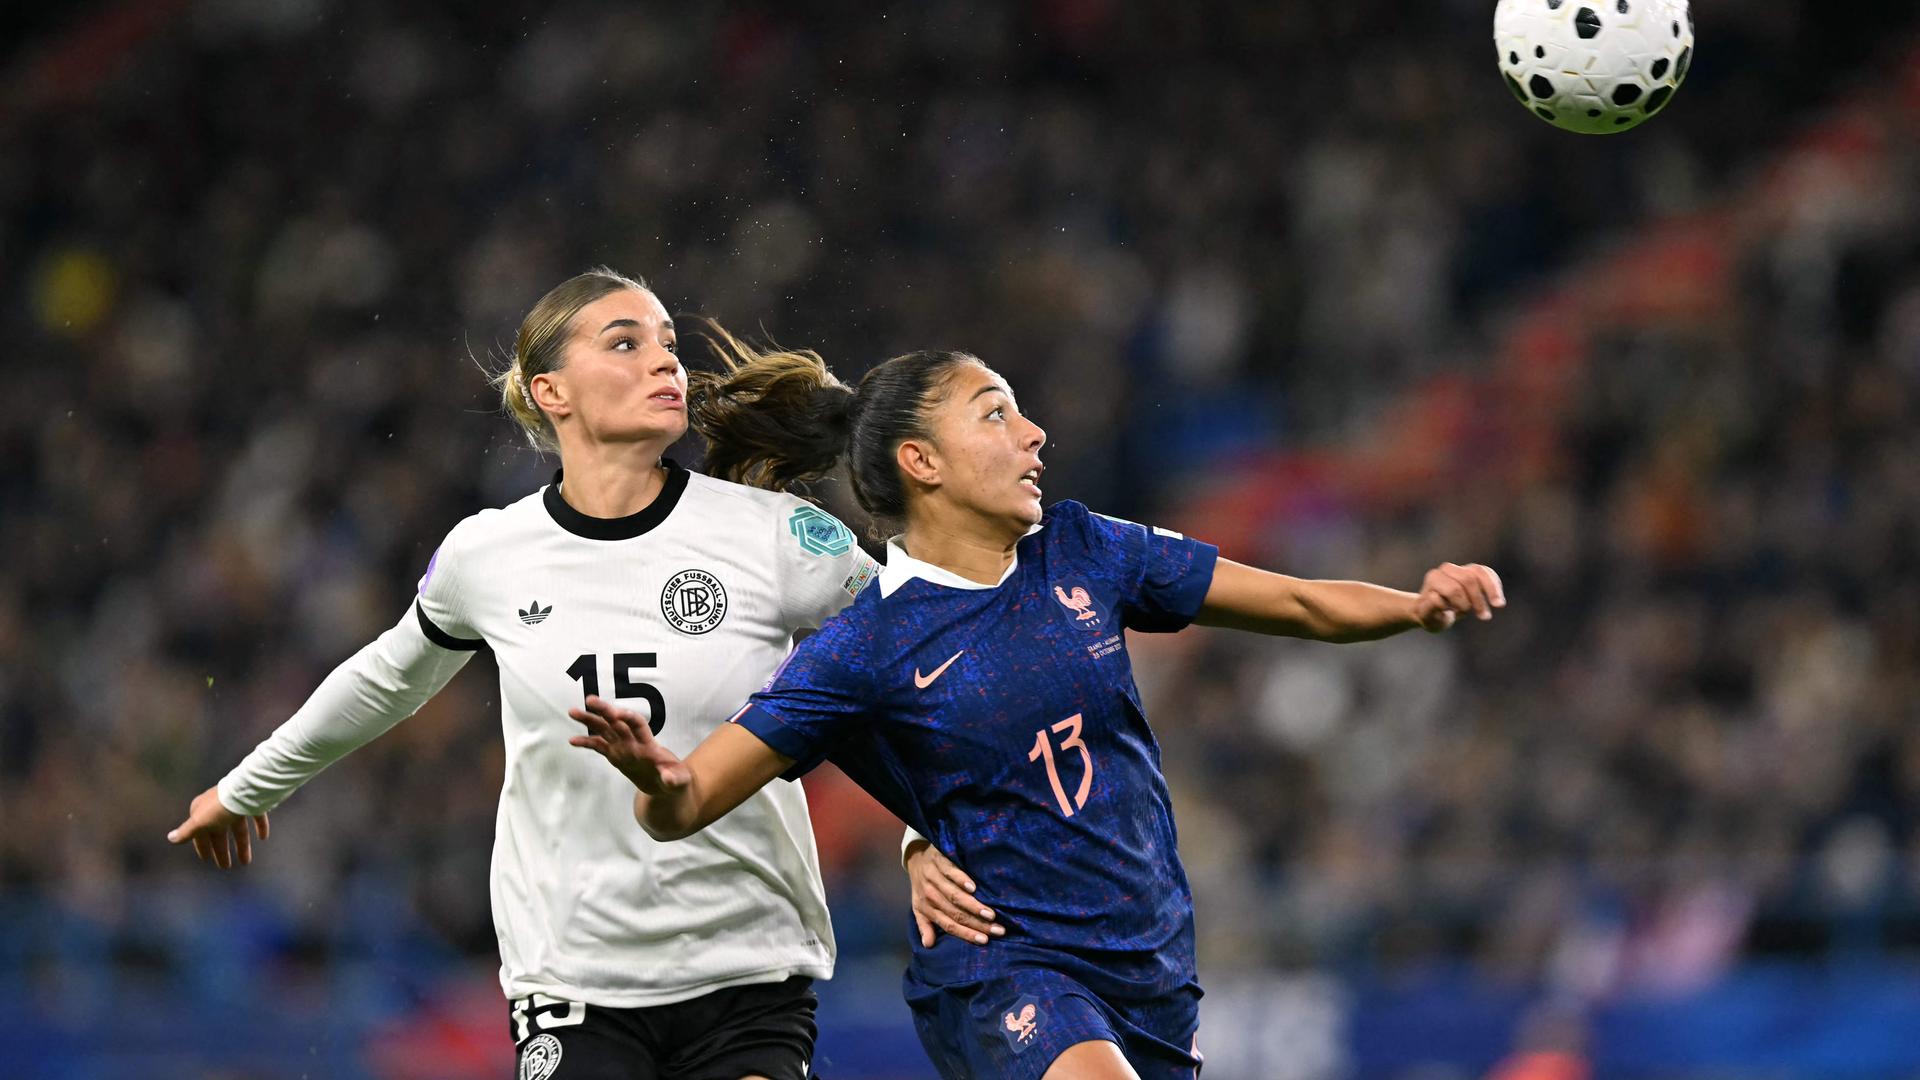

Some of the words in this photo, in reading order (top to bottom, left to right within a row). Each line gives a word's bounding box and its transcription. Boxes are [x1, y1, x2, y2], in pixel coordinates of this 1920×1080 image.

[664, 578, 684, 626] DEUTSCHER
[566, 652, 666, 736] 15
[1028, 712, 1093, 818] 13
[512, 994, 586, 1046] 15
